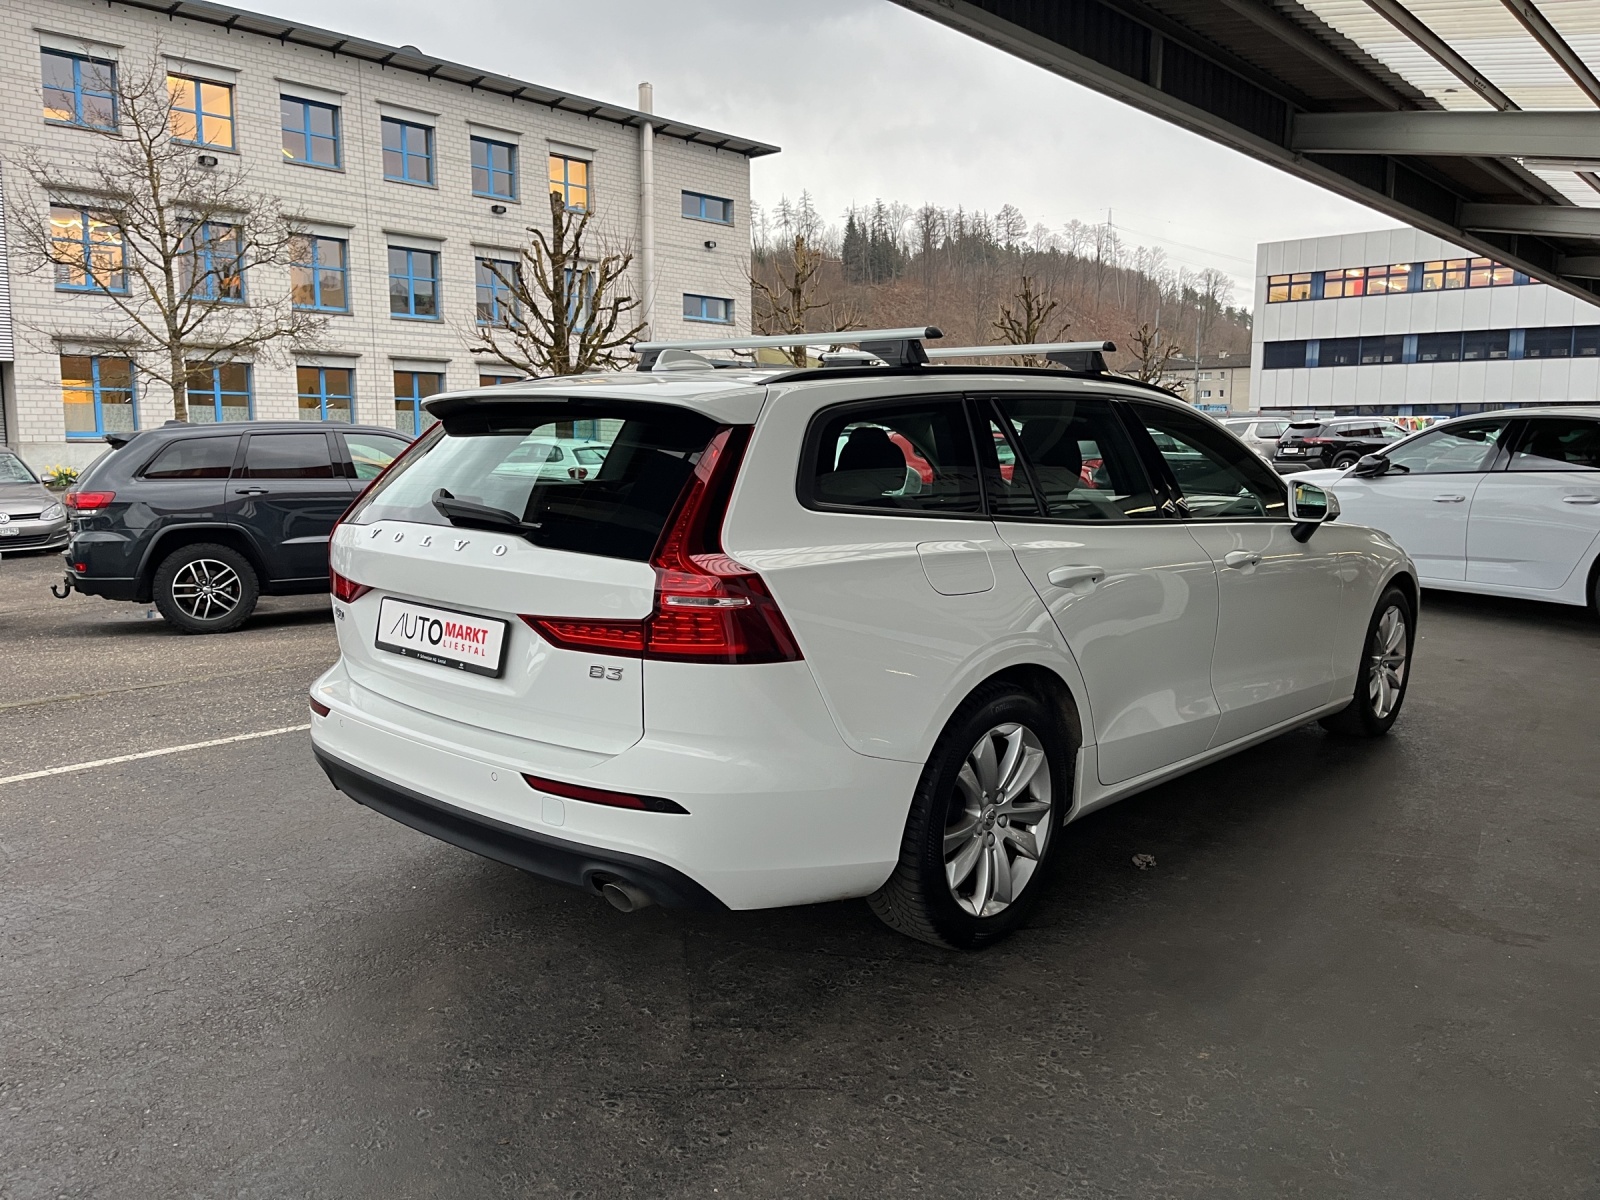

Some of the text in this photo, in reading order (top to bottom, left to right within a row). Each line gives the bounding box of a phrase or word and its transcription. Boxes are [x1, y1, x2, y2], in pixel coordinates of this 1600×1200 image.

[370, 528, 507, 556] VOLVO
[443, 639, 486, 657] LIESTAL
[589, 665, 624, 681] B3
